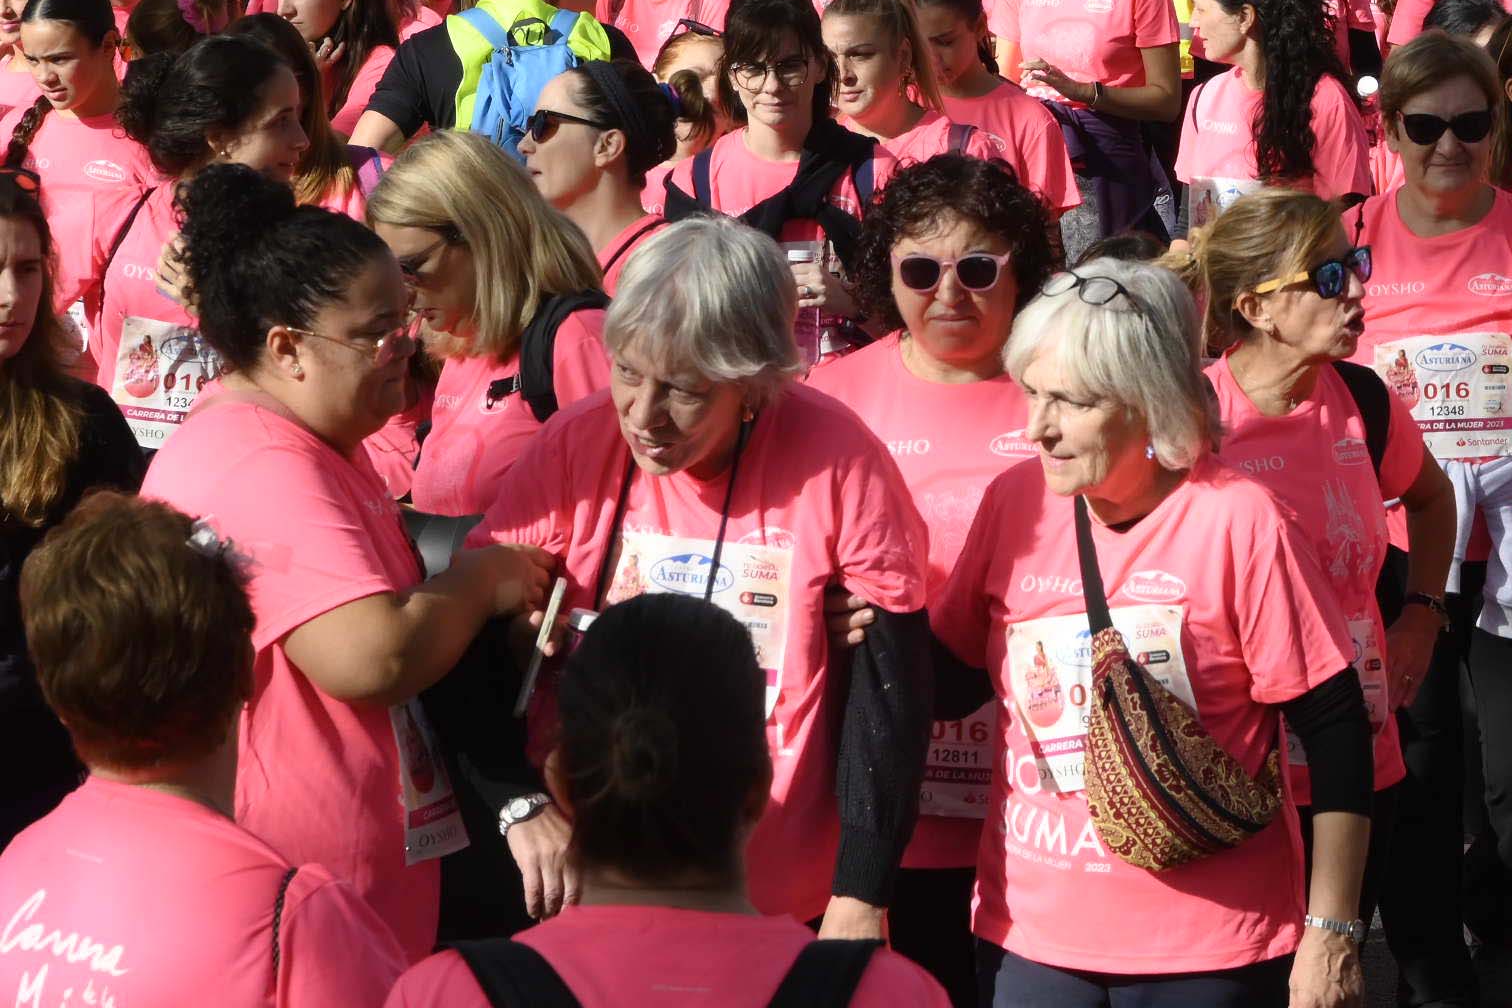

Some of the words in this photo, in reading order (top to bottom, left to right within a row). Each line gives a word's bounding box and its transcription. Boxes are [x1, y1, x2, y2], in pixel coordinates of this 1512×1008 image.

[123, 263, 155, 281] OYS
[1481, 348, 1508, 357] SUMA
[1420, 354, 1473, 368] ASTURIANA
[1423, 381, 1471, 401] 016
[127, 409, 166, 421] CARRERA
[1429, 405, 1465, 417] 12348
[1432, 422, 1444, 430] DE
[1444, 421, 1455, 430] LA
[1456, 421, 1484, 430] MUJER
[131, 426, 165, 441] YSHO
[995, 437, 1041, 454] ASTURIA
[1466, 436, 1508, 449] Santander
[1239, 455, 1285, 474] YSHO
[742, 569, 780, 581] SUMA
[933, 748, 980, 764] 12811
[1003, 800, 1106, 857] UMA
